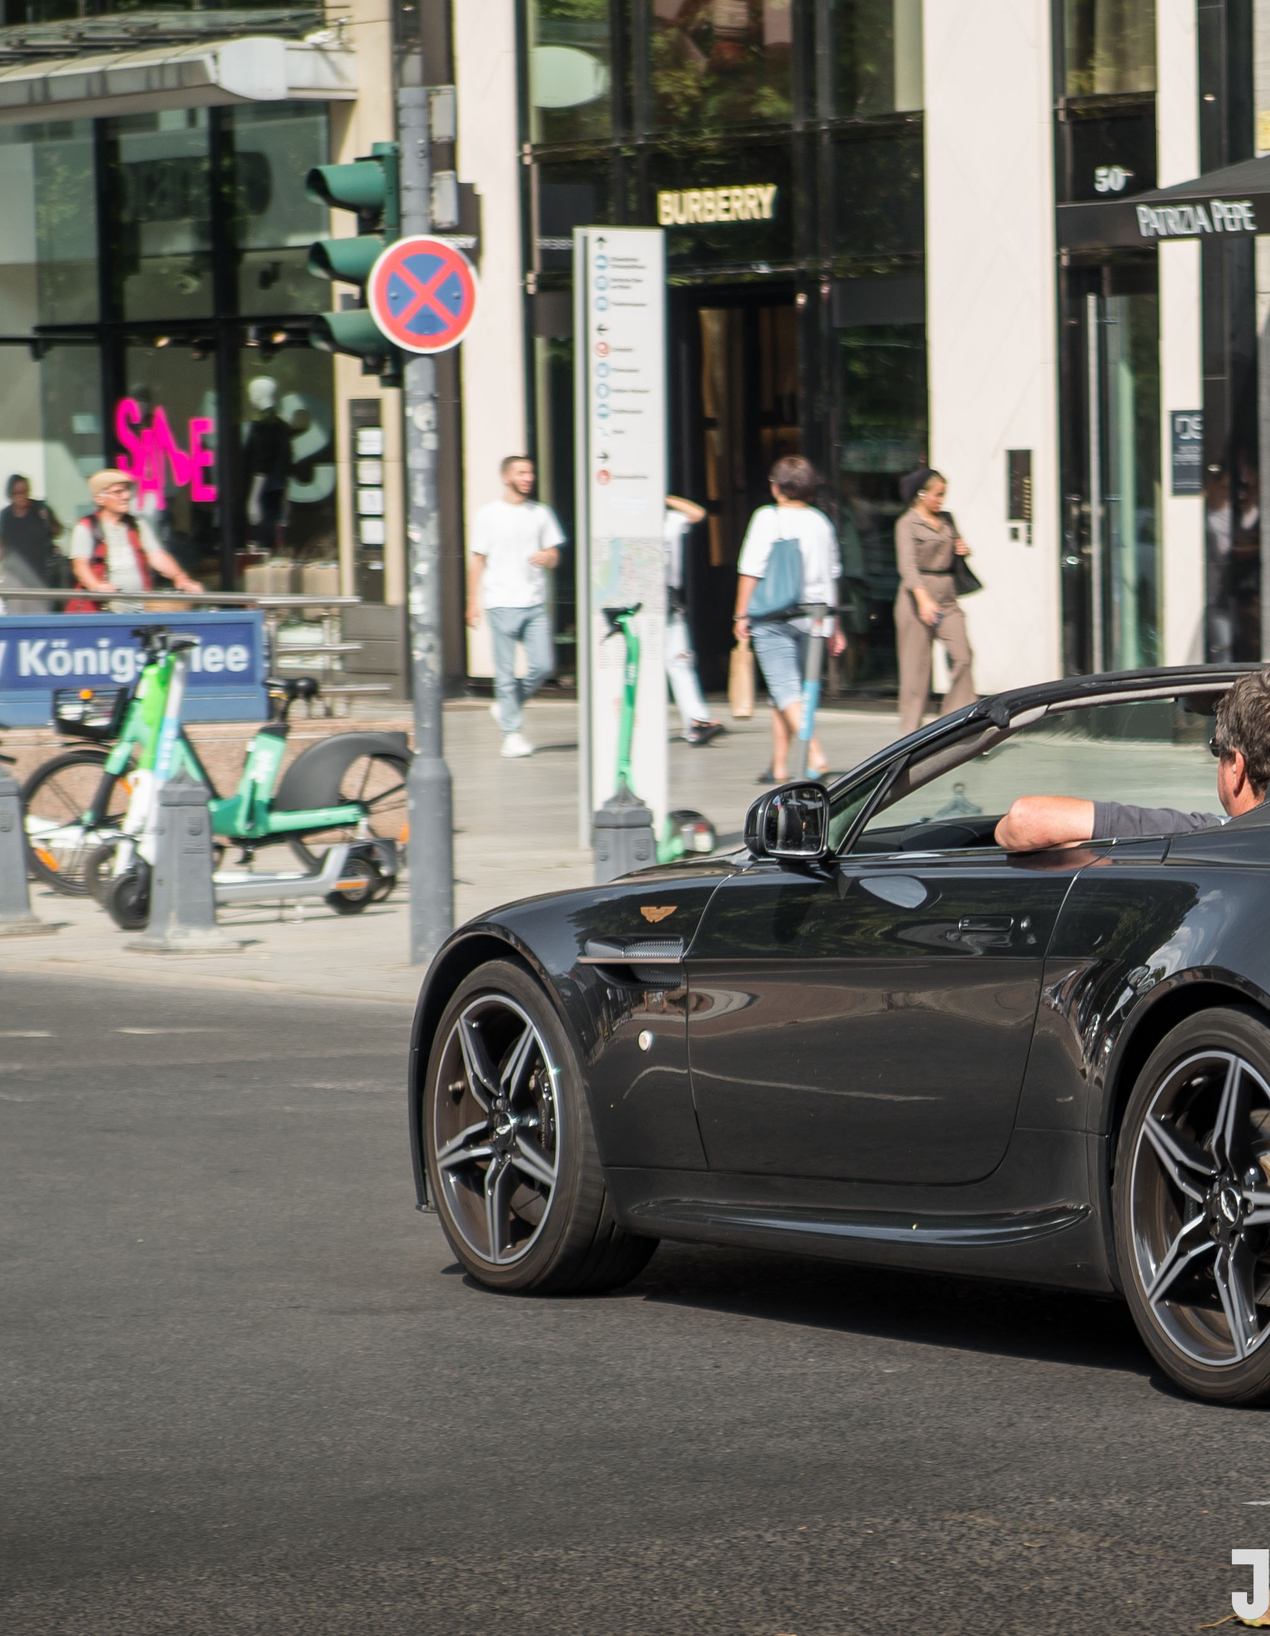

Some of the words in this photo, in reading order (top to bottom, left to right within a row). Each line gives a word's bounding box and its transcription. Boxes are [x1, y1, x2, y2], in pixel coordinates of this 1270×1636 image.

[657, 183, 778, 226] BURBERRY
[1136, 203, 1213, 237] PATRIZIA
[1209, 199, 1259, 233] PEPE
[115, 397, 218, 511] SALE
